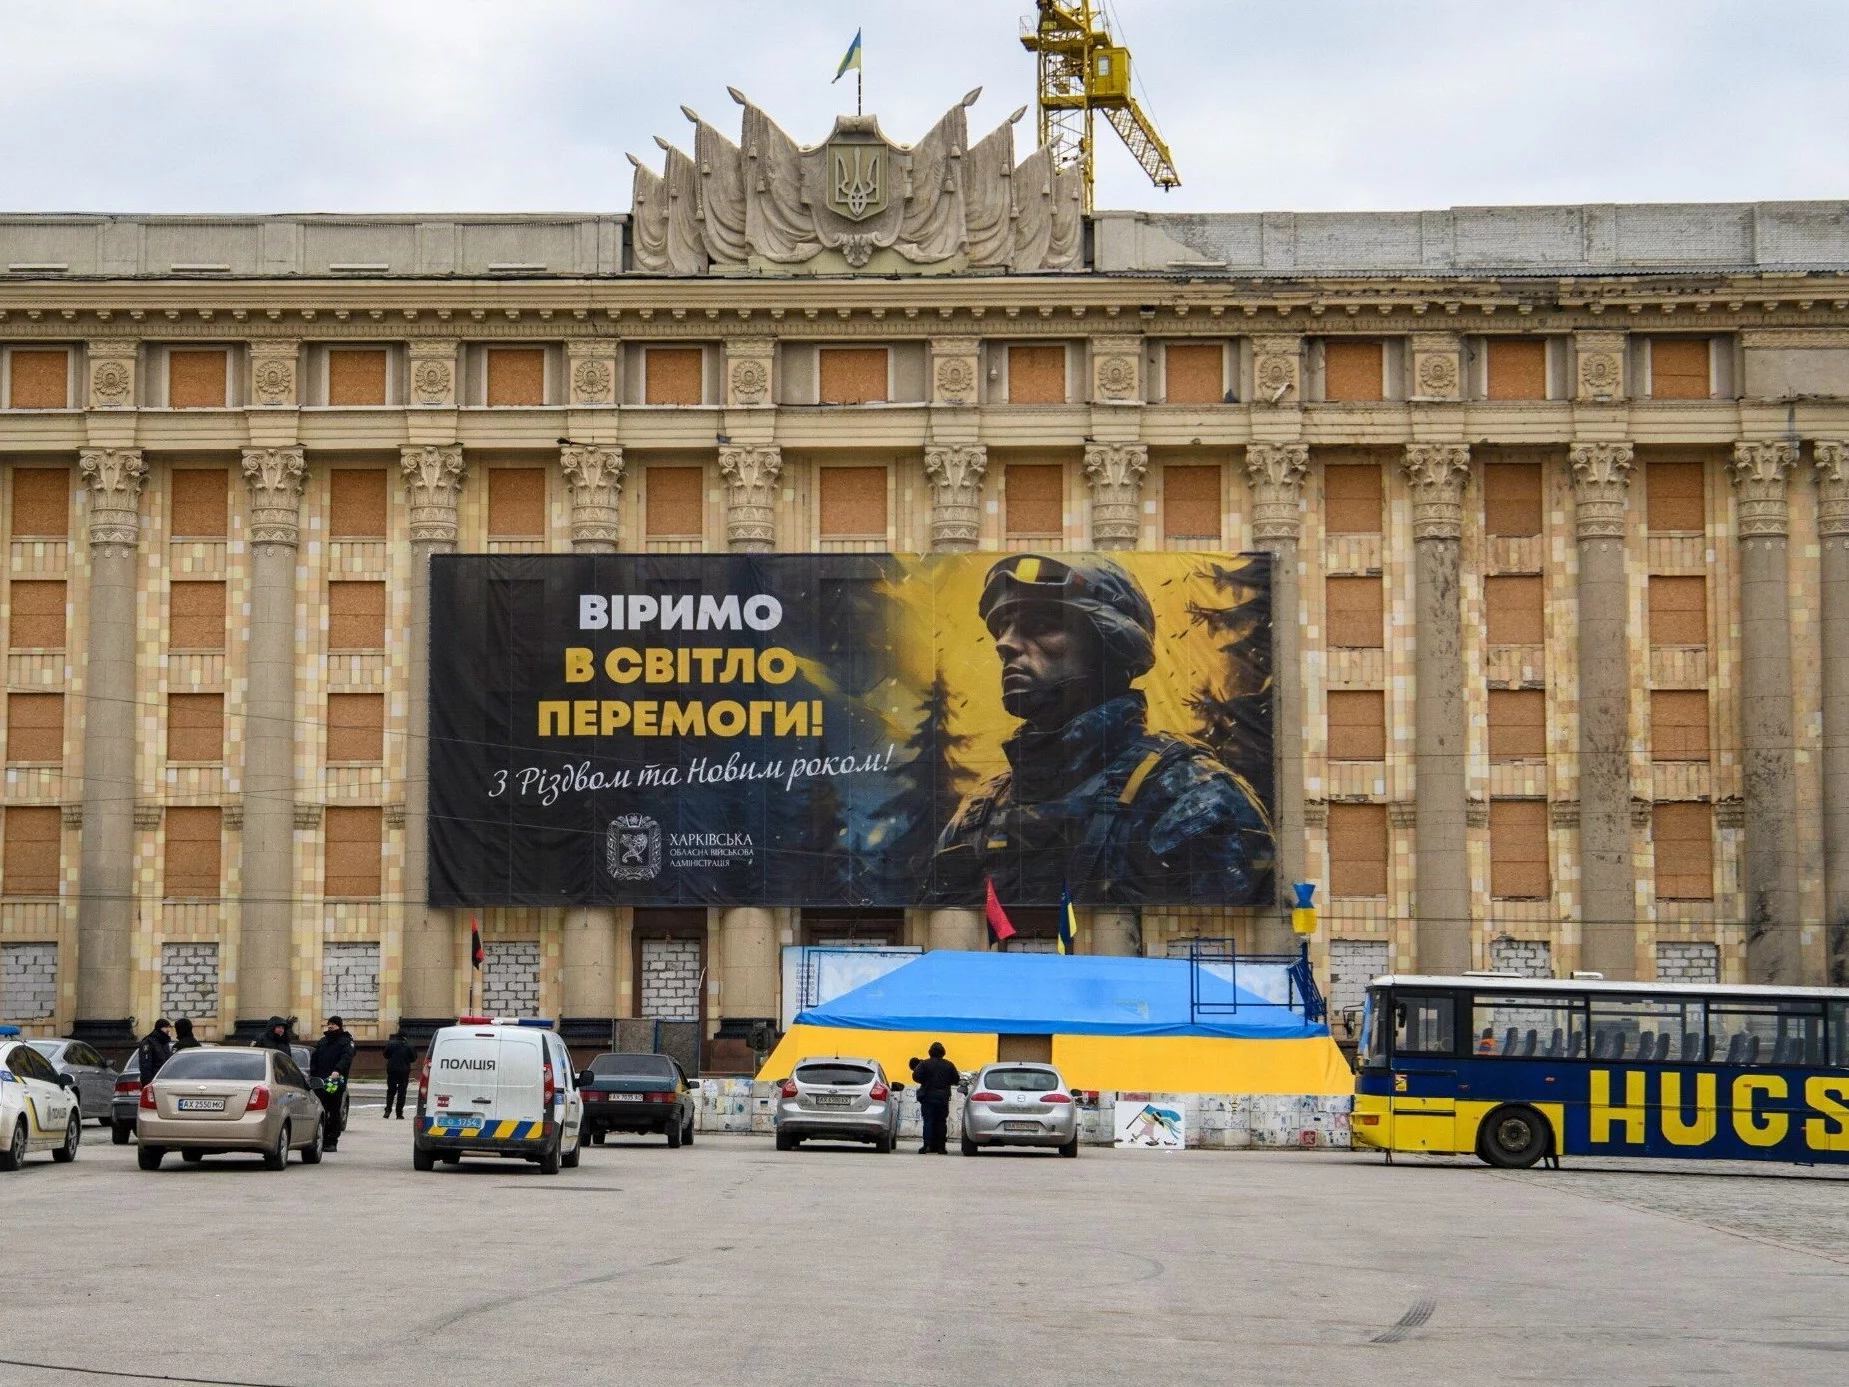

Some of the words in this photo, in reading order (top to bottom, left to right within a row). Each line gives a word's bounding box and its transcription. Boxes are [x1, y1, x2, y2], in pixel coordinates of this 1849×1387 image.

[579, 594, 783, 631] ВІРИМО
[565, 647, 595, 683] В
[604, 646, 797, 684] СВІТЛО
[538, 700, 823, 737] ПЕРЕМОГИ!
[488, 769, 508, 797] З
[516, 760, 632, 806] Різдвом
[637, 763, 682, 787] та
[687, 751, 785, 784] Новим
[785, 743, 895, 792] роком!
[669, 848, 709, 857] ОБЛАСНА
[710, 848, 754, 856] ВІЙСЬКОВА
[670, 833, 753, 846] ХАРКІВСЬКА
[670, 859, 730, 867] АДМІНІСТРАЦІЯ
[440, 1058, 496, 1071] ПОЛІЦІЯ
[1590, 1069, 1849, 1151] HUGS
